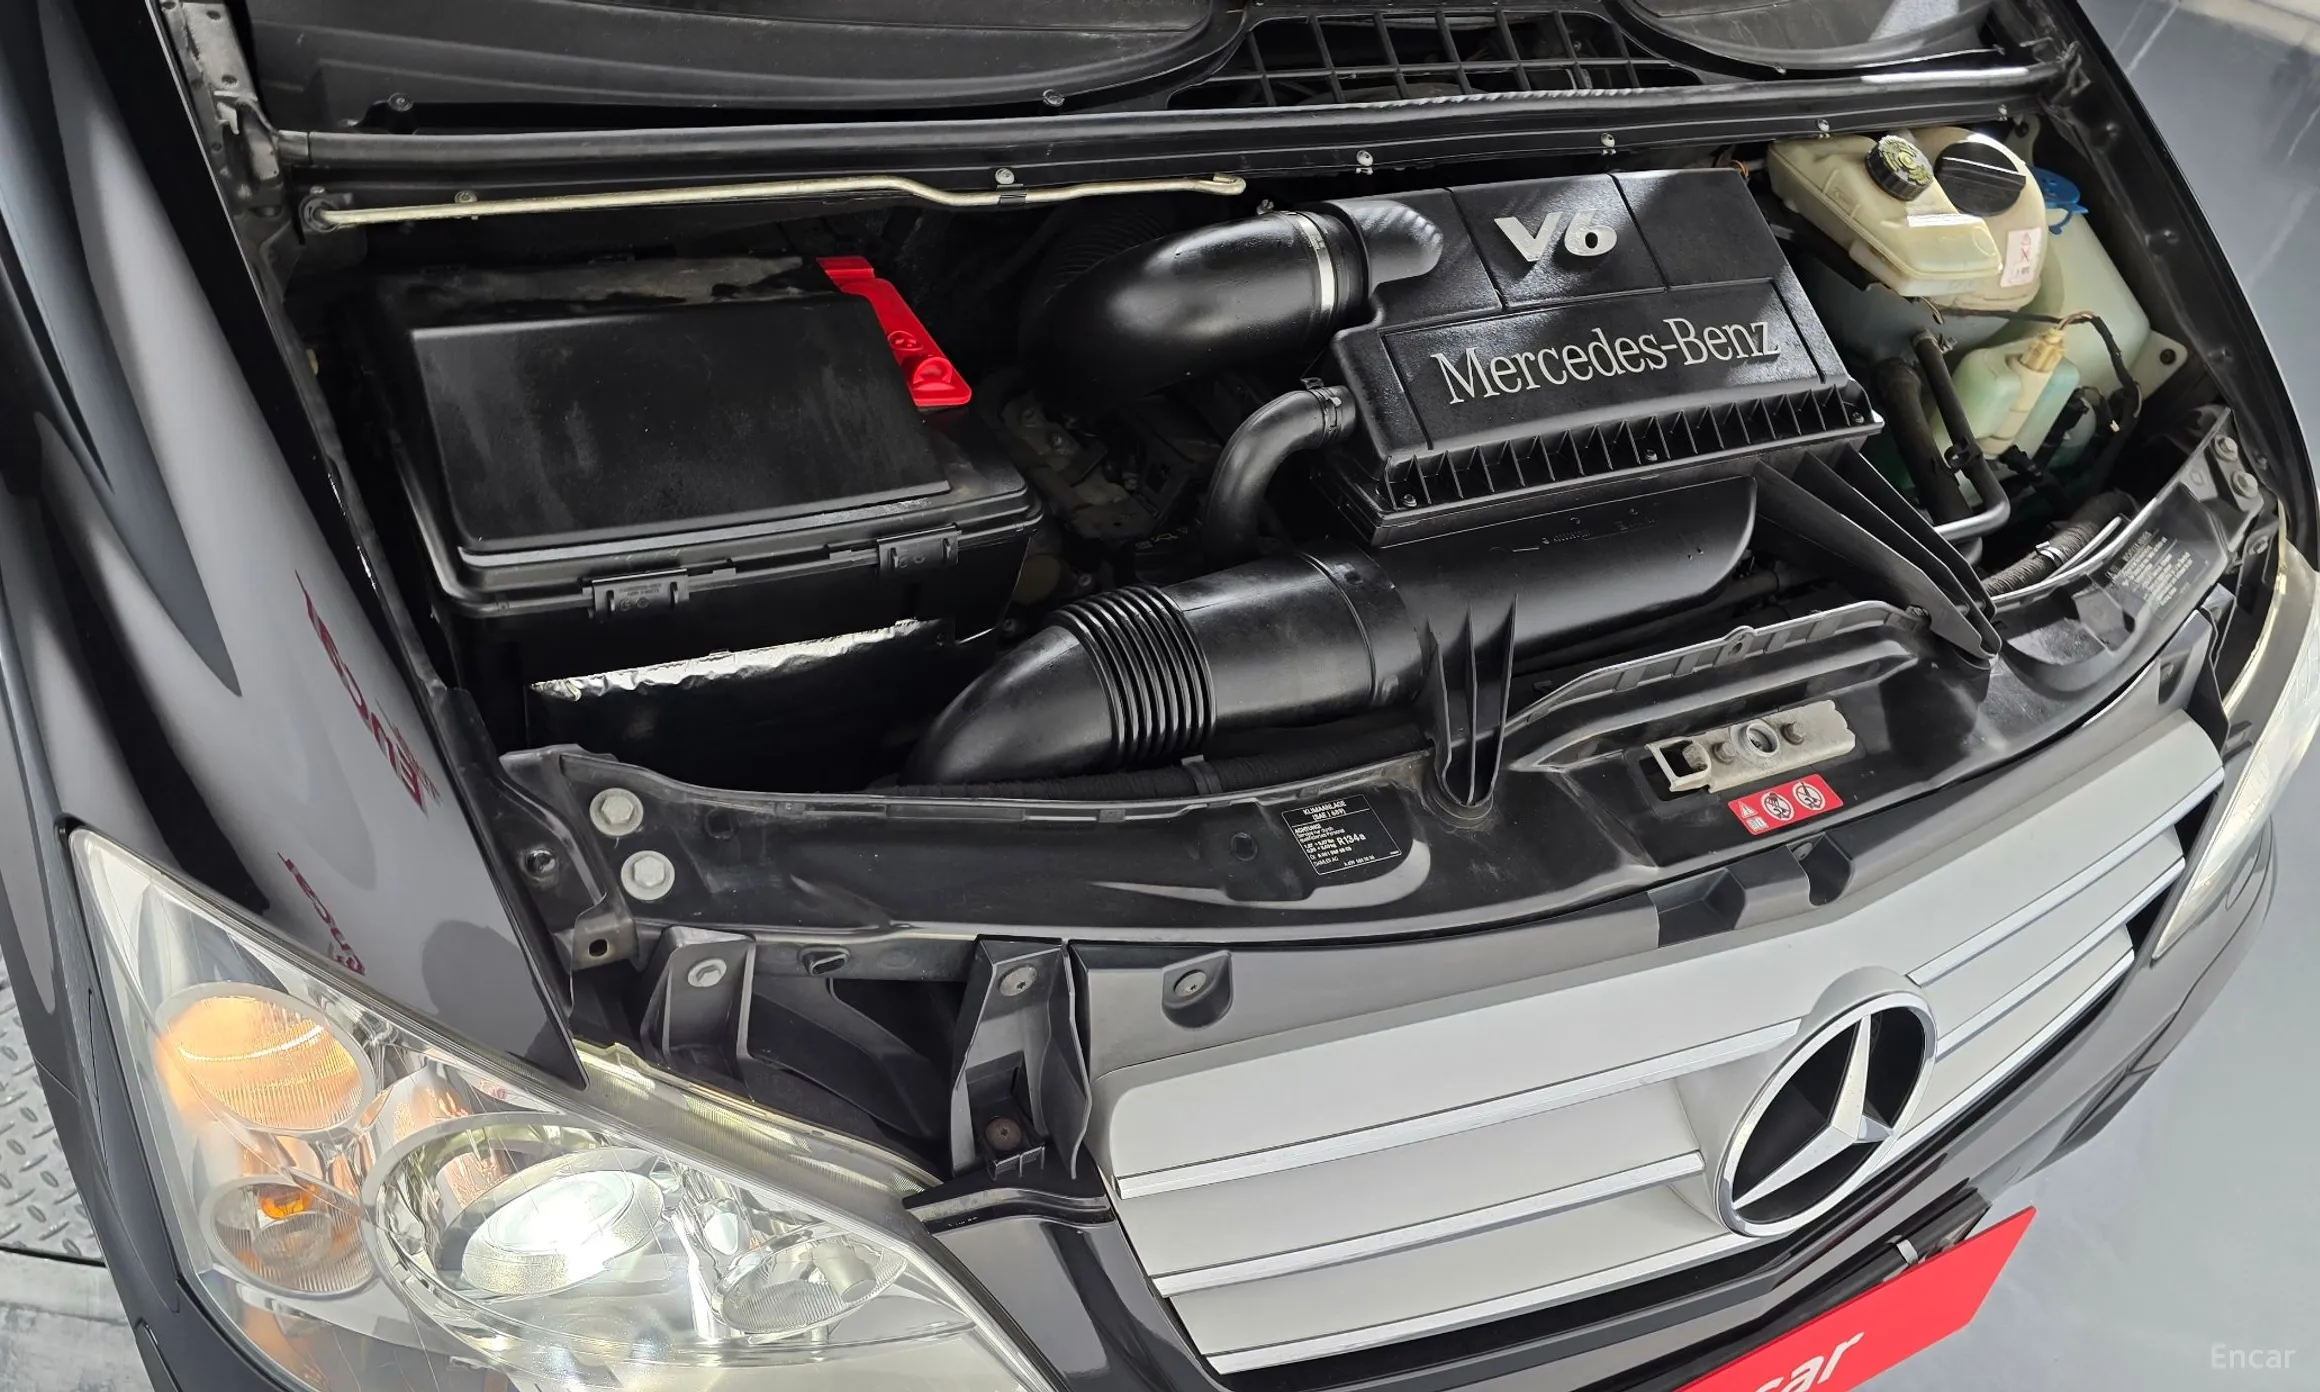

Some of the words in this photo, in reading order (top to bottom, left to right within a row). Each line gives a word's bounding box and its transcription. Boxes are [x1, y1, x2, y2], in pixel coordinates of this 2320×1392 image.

[1494, 208, 1618, 262] V6
[1430, 317, 1781, 405] Mercedes-Benz
[1336, 832, 1367, 846] R134a
